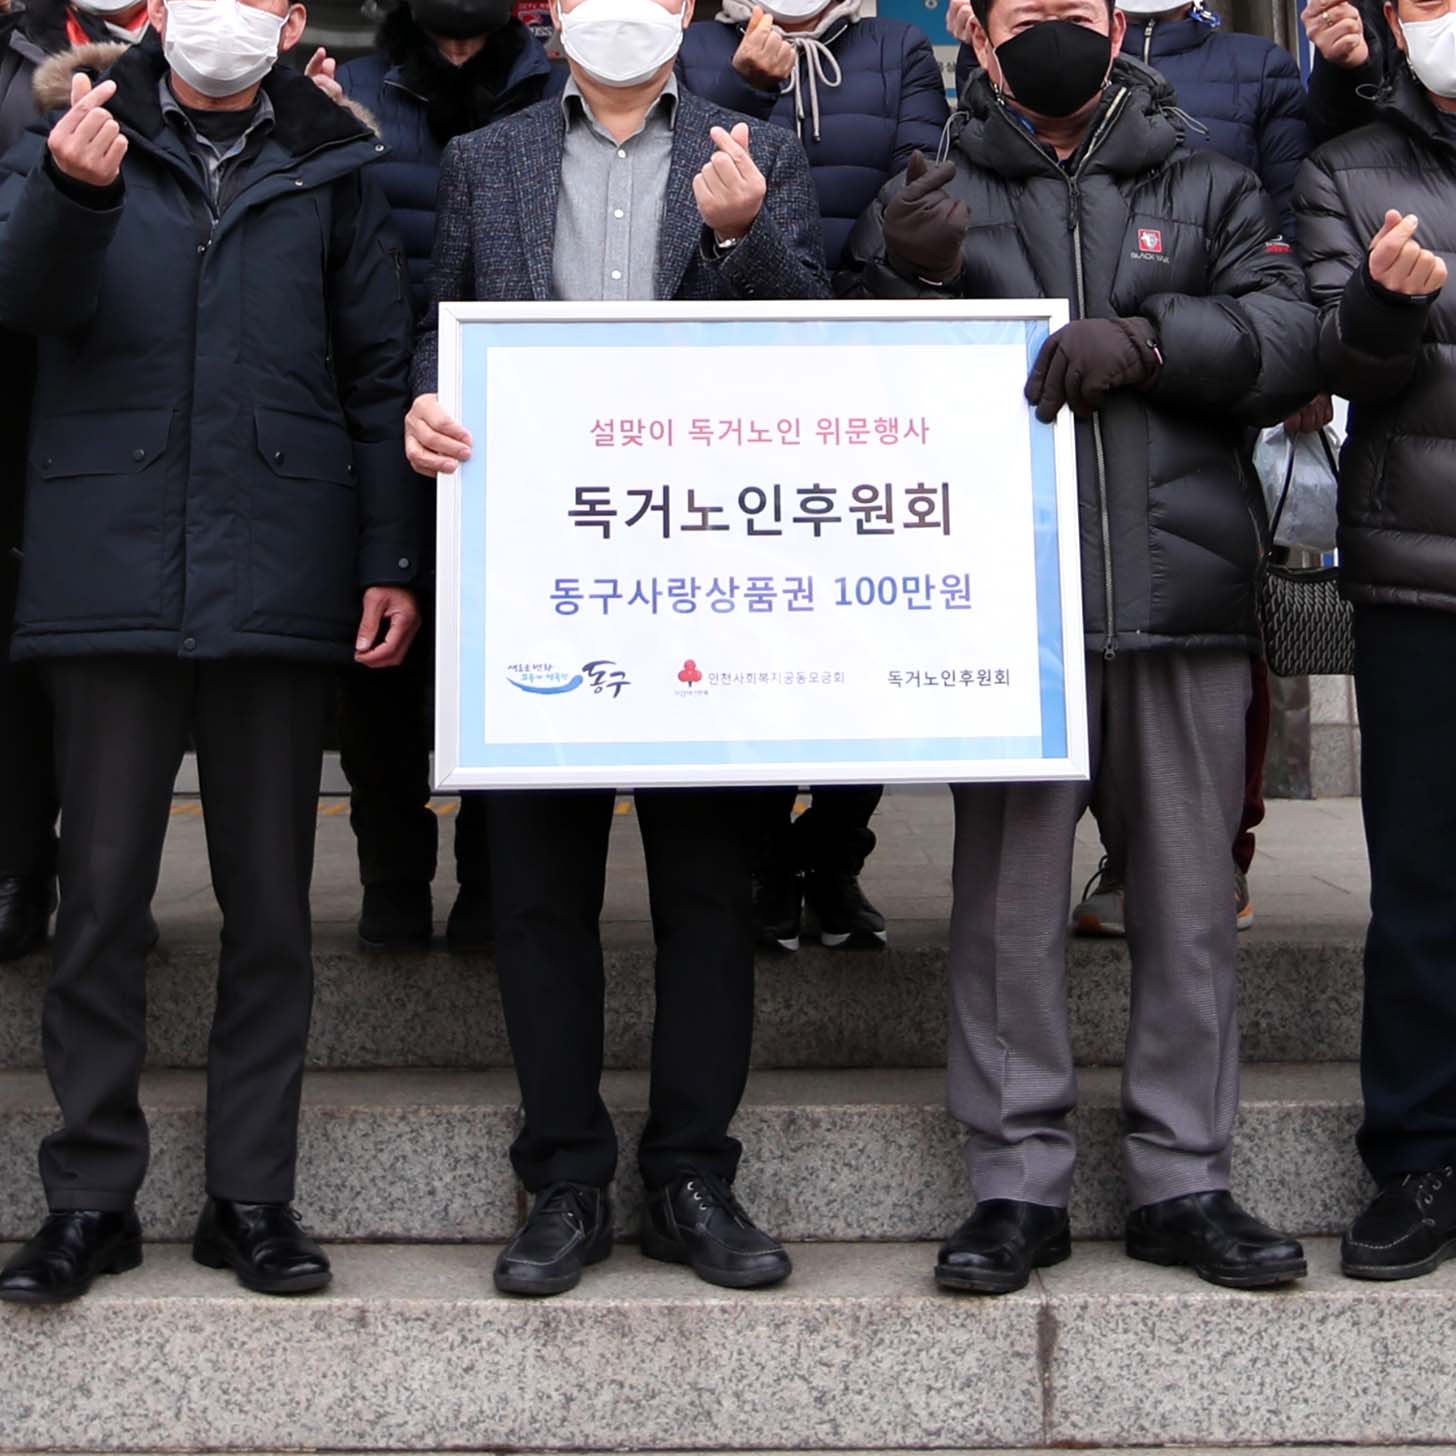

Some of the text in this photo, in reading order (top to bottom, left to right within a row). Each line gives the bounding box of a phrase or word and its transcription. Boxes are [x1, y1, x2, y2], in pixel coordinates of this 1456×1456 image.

[589, 416, 930, 447] 설맞이 독거노인 위문행사
[567, 481, 951, 540] 독거노인후원회
[549, 573, 972, 616] 동구사랑상품권 100만원
[581, 660, 632, 699] 동구
[887, 668, 1010, 689] 독거노인후원회
